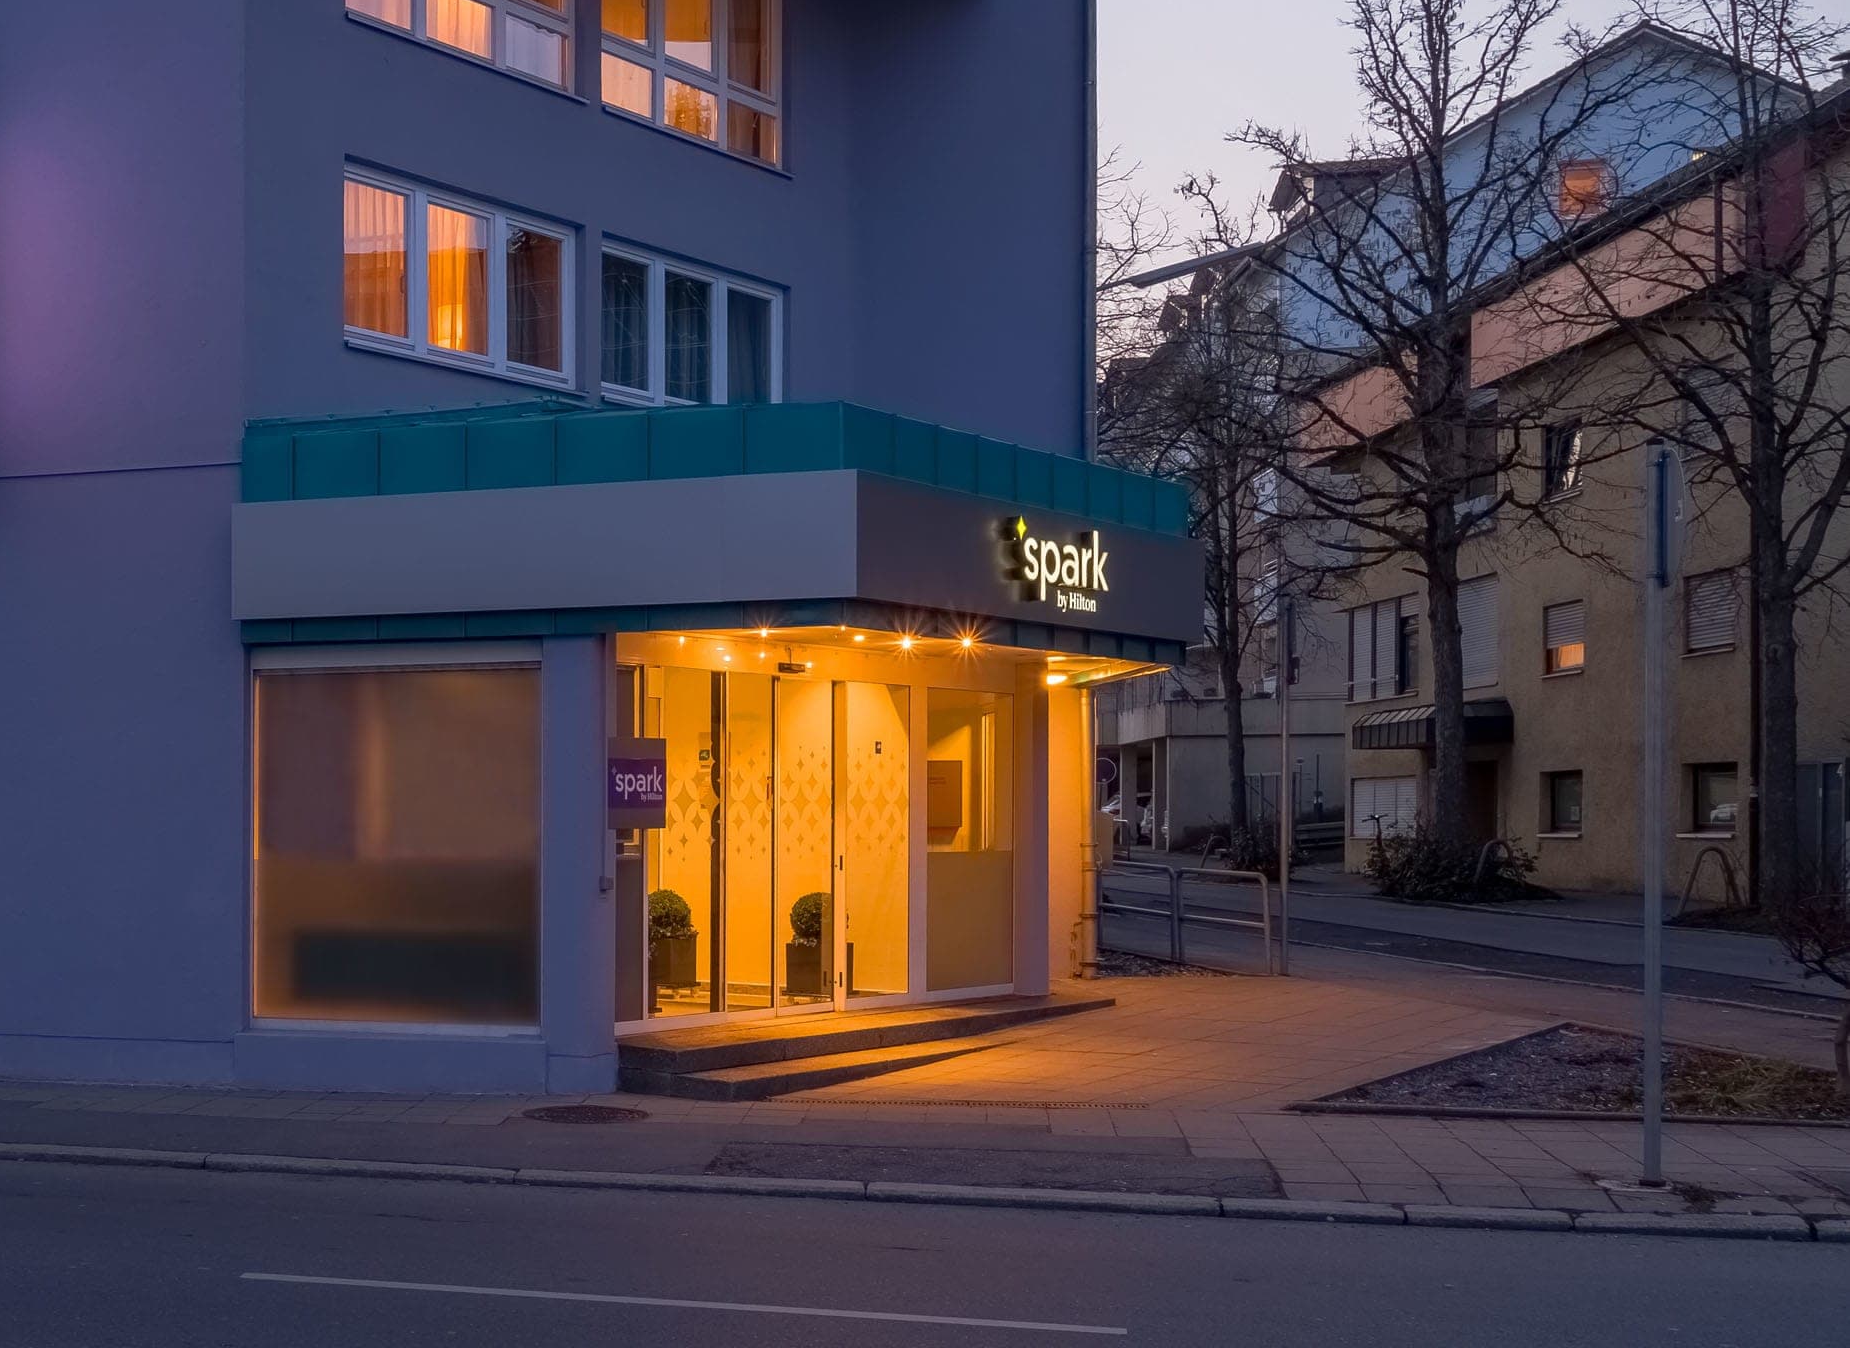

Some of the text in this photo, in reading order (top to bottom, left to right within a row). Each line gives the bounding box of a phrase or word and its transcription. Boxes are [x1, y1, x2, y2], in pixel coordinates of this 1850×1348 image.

[1024, 530, 1109, 601] spark
[1057, 589, 1097, 613] by Hilton
[615, 766, 663, 801] spark
